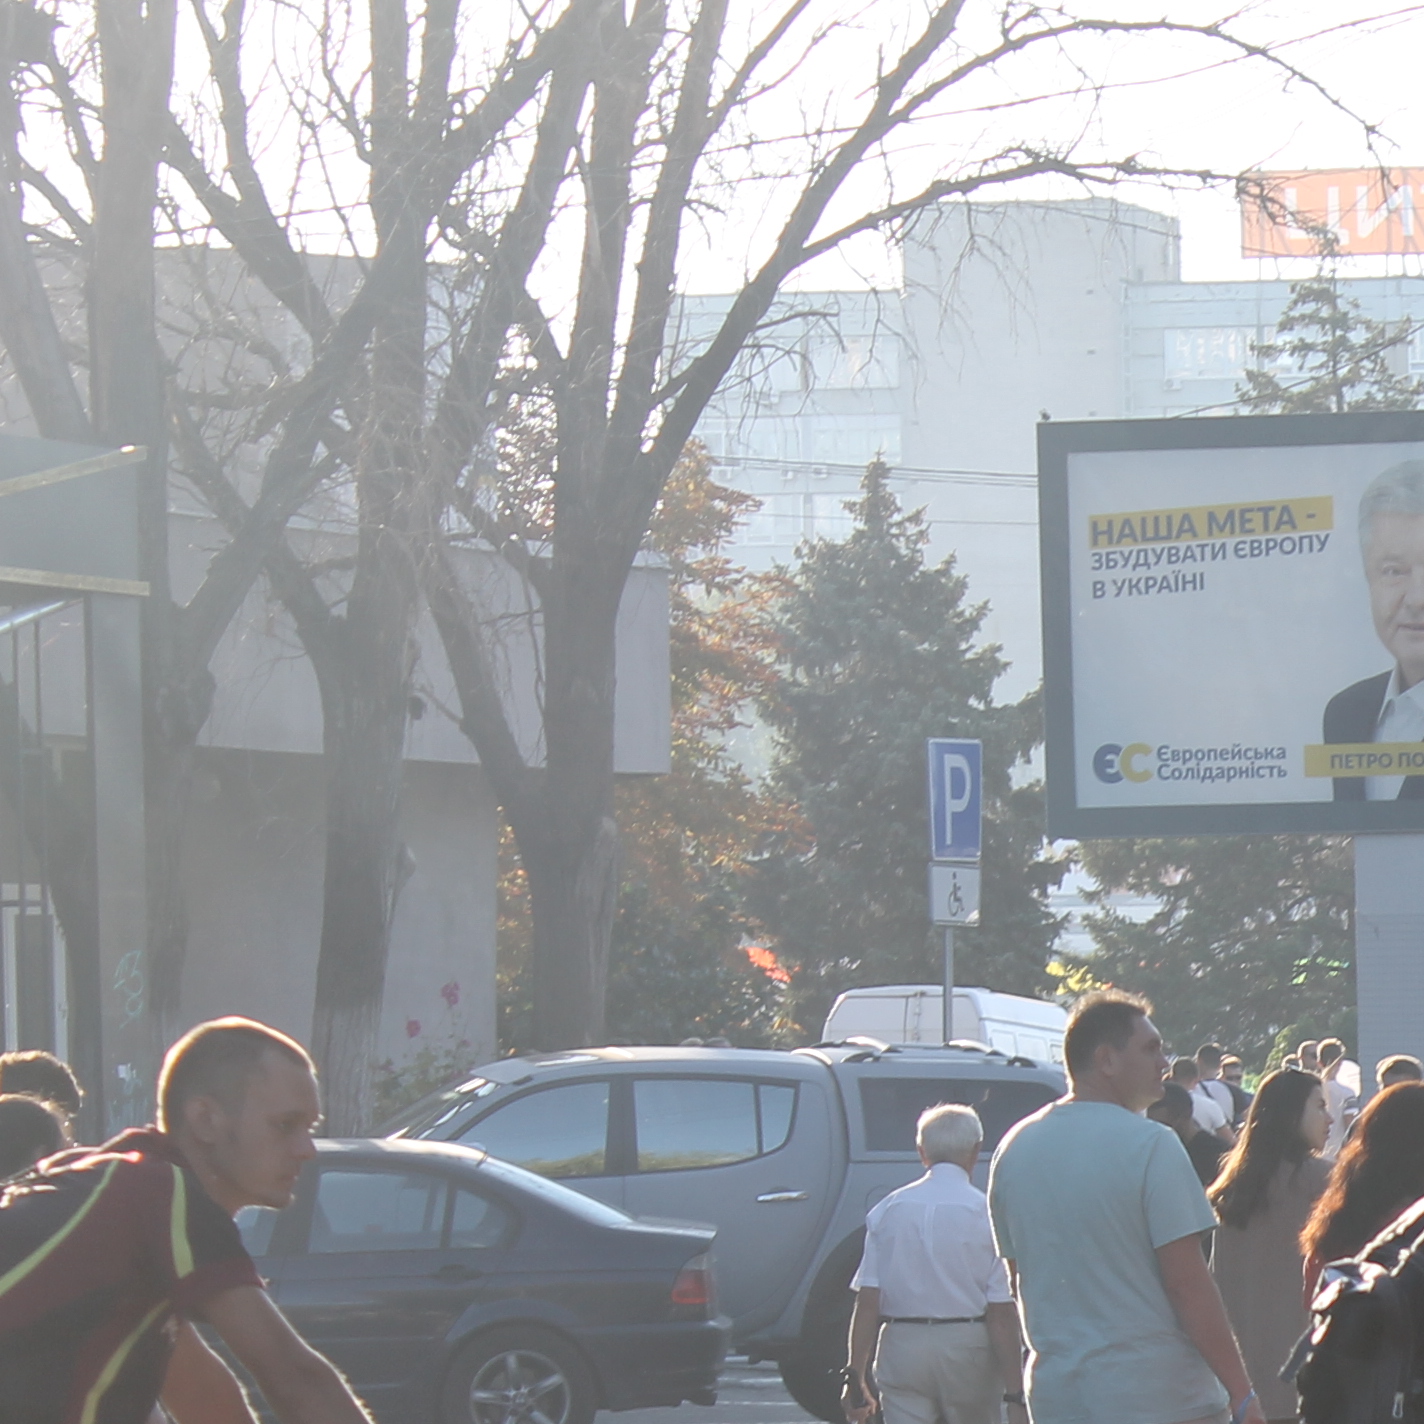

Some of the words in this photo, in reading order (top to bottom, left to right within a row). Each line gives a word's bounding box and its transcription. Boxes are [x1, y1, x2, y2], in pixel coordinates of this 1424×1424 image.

[1091, 513, 1197, 547] НАША
[1206, 504, 1298, 536] МЕТА
[1091, 541, 1227, 572] ЗБУДУВАТИ
[1233, 532, 1331, 560] ЄВРОПУ
[1092, 578, 1106, 599] В
[1111, 569, 1206, 598] УКРАЇНІ
[1157, 742, 1287, 766] Європейська
[1330, 752, 1392, 770] ПЕТРО
[1157, 760, 1288, 785] Солідарність
[944, 753, 973, 846] P
